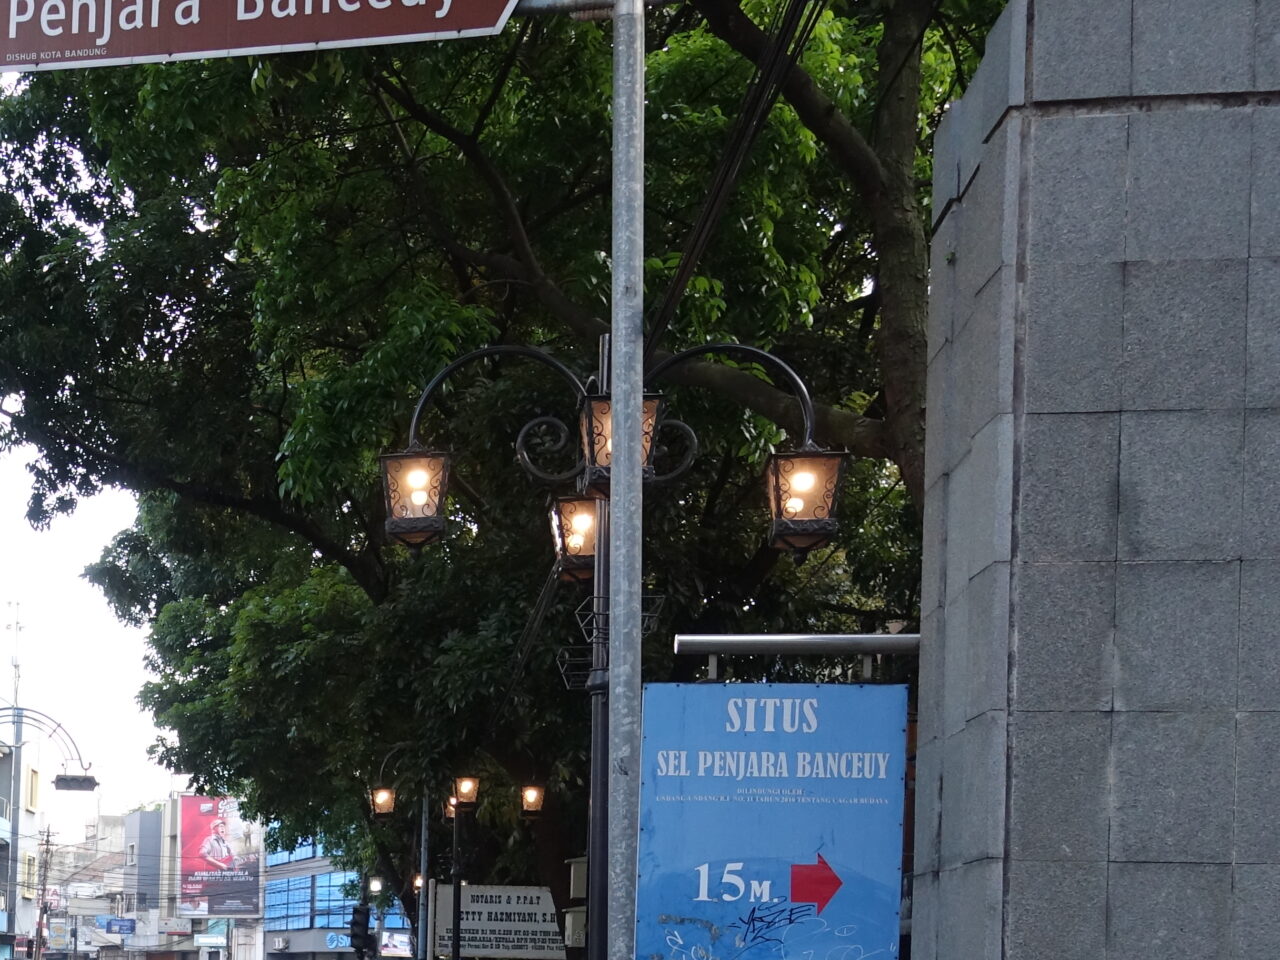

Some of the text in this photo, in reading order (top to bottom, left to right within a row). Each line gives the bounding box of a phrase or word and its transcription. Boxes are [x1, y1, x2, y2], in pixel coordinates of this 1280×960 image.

[8, 0, 201, 46] Penjara
[6, 48, 108, 61] DISHUB KOTA BANDUNG
[725, 698, 819, 733] SITUS
[657, 751, 890, 781] SEL PENJARA BANCEUY
[470, 894, 502, 904] NOTARIS
[505, 895, 512, 905] &
[459, 910, 483, 922] ETTY
